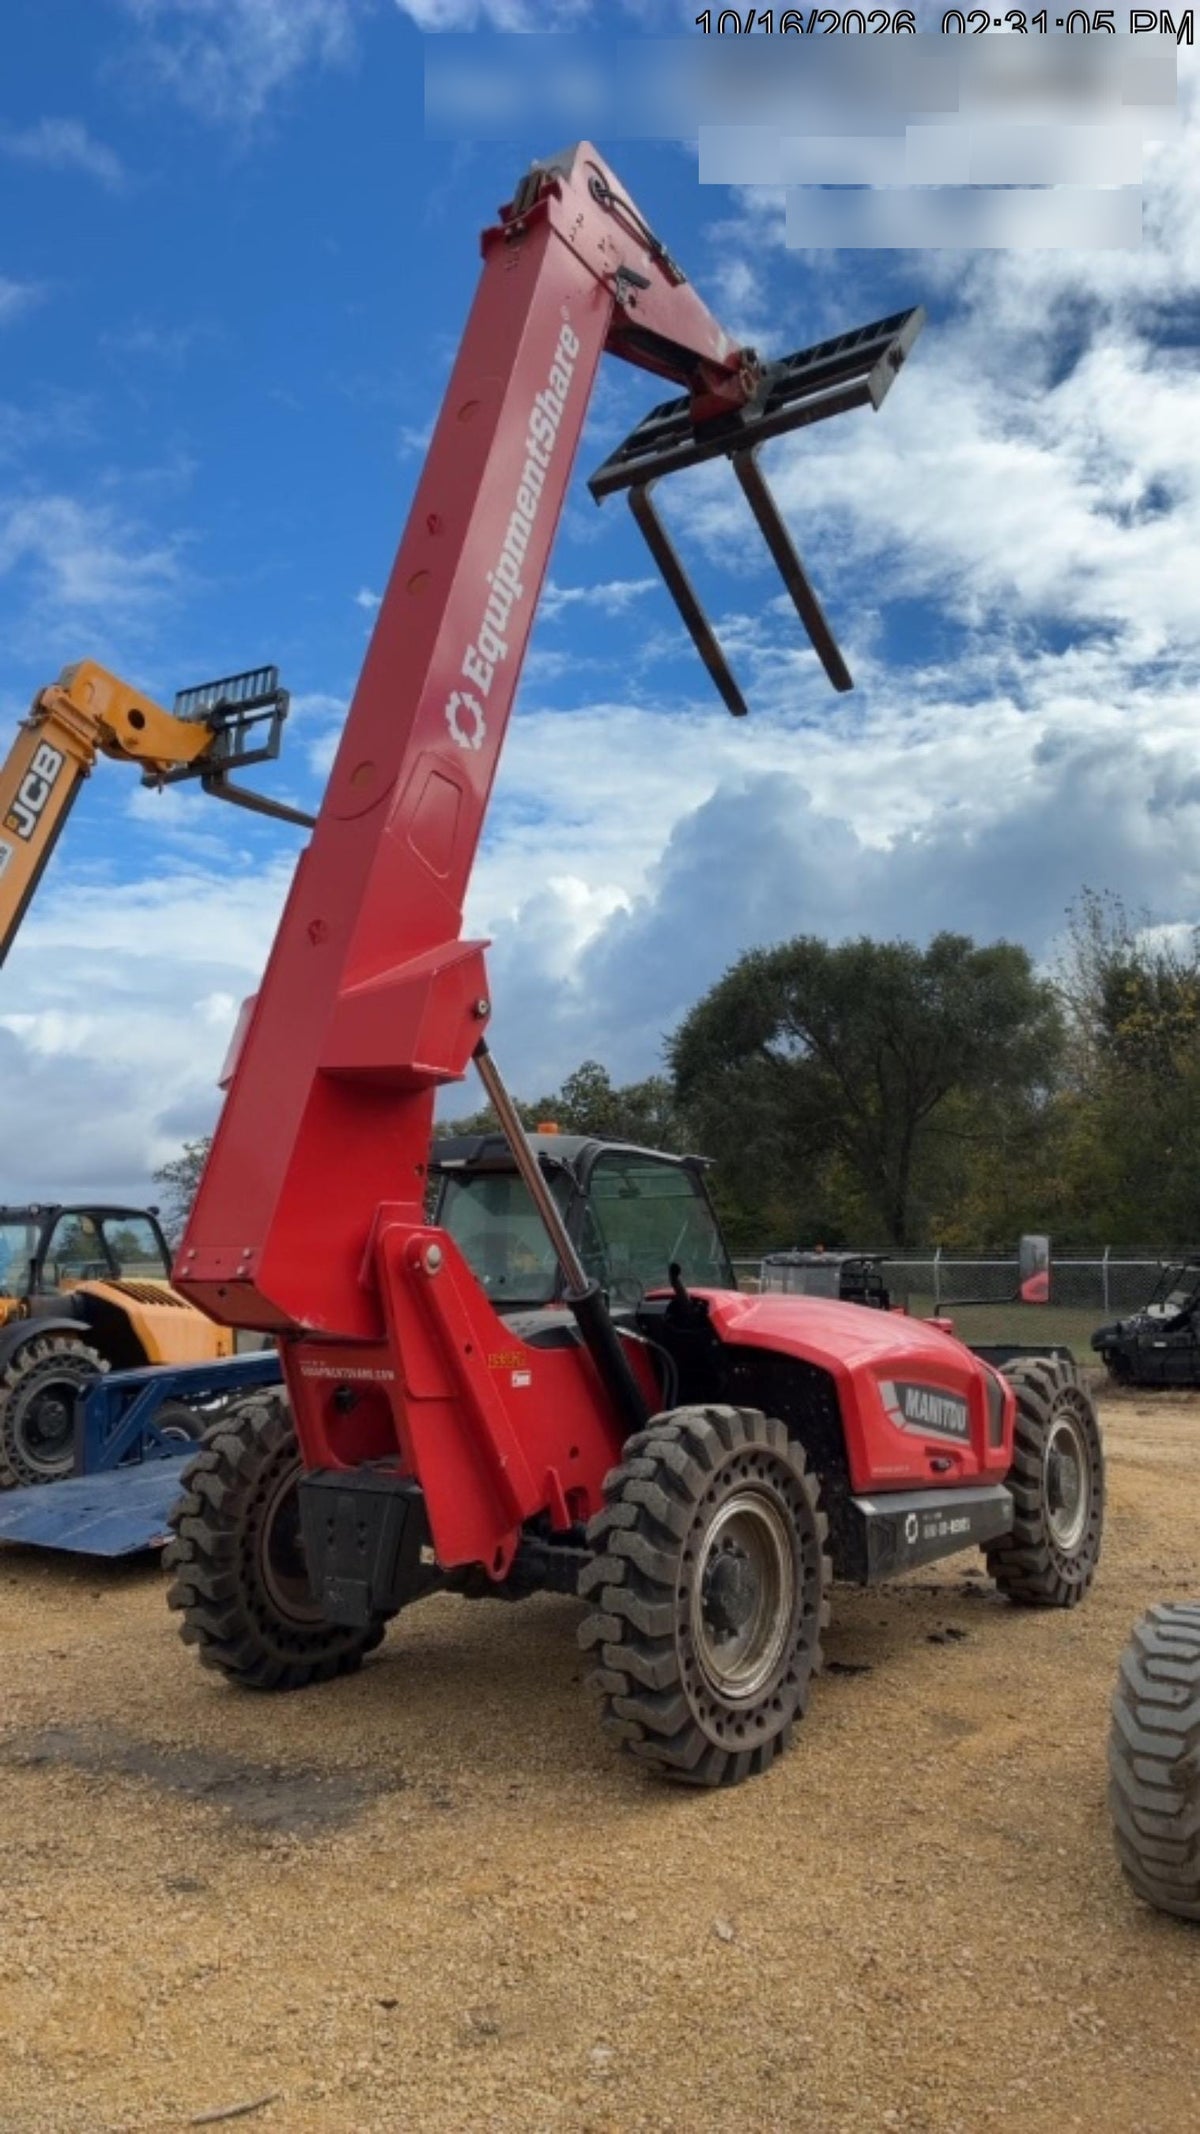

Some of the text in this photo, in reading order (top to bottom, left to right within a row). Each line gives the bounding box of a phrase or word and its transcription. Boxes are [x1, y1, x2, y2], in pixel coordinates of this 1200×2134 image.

[462, 323, 580, 696] EquipmentShare
[12, 743, 64, 838] JCB
[905, 1387, 966, 1432] MANITOU
